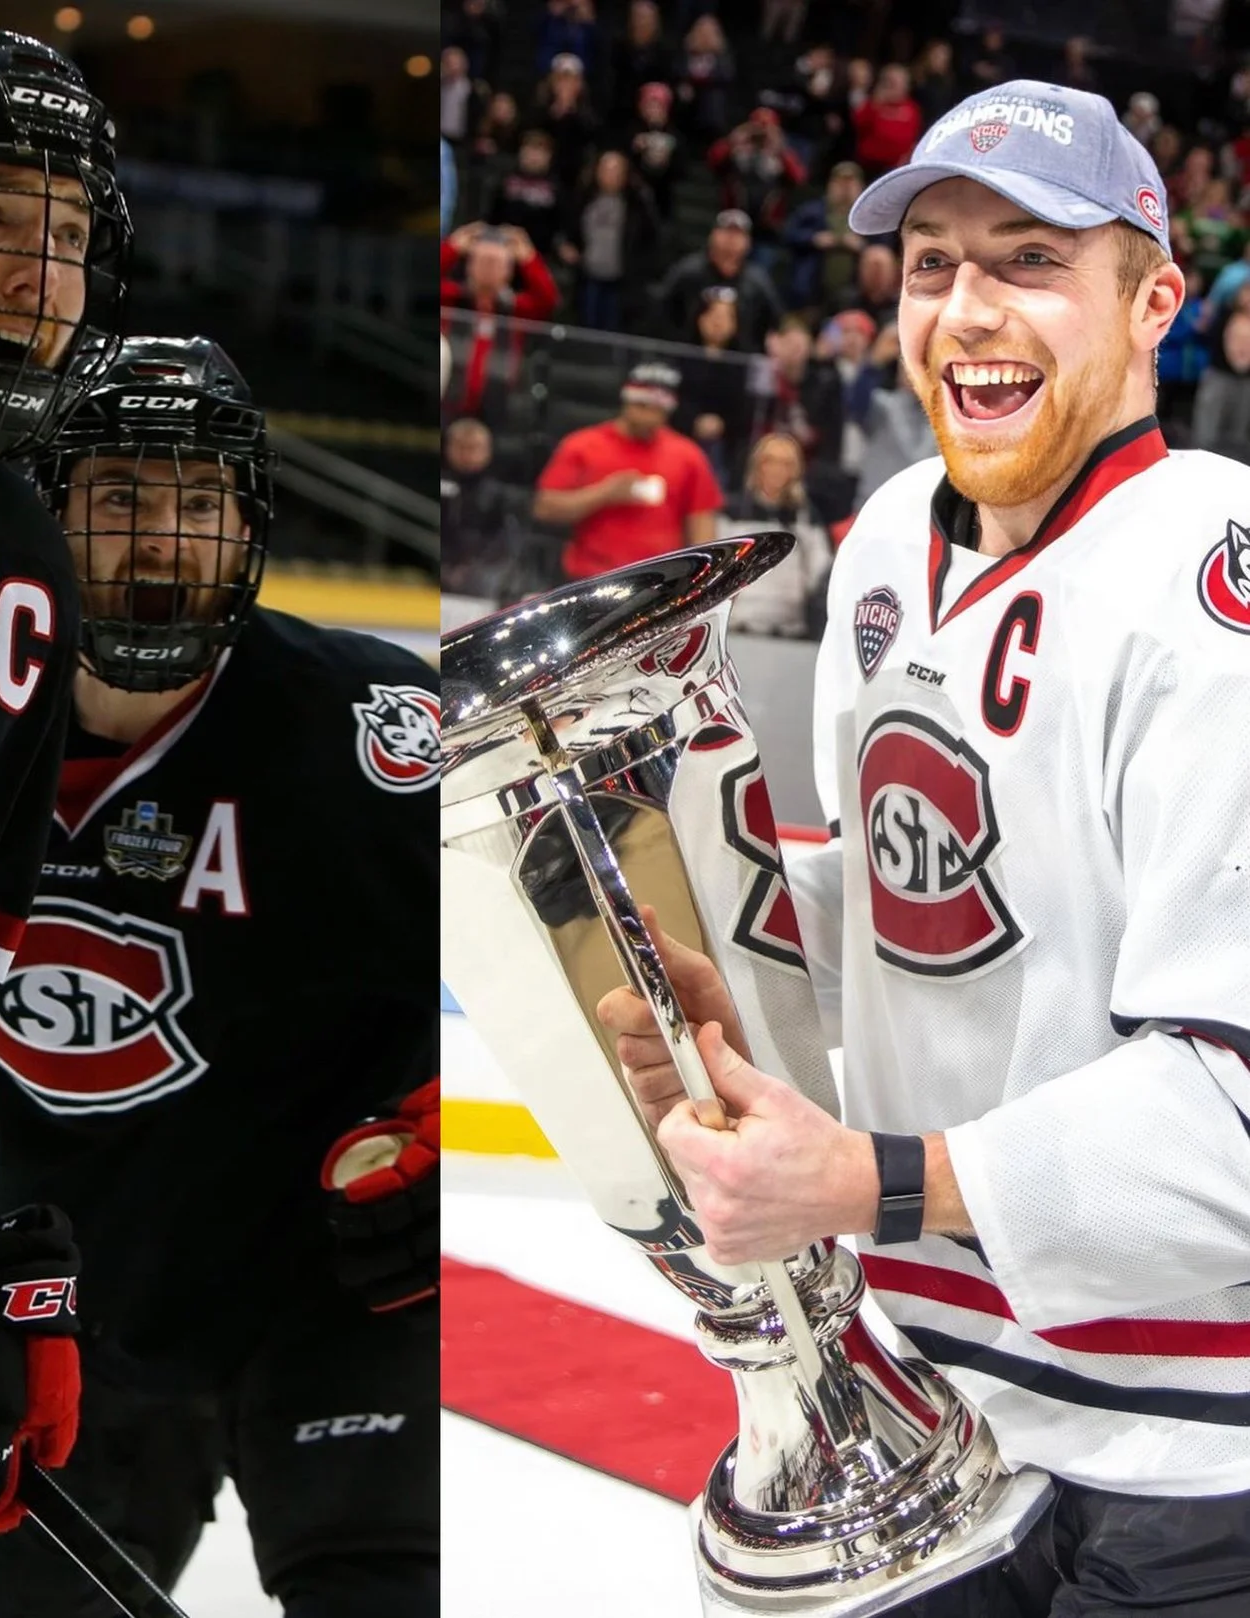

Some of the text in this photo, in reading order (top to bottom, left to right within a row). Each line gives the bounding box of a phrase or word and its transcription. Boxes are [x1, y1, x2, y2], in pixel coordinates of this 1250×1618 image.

[12, 86, 89, 118] CCM
[925, 103, 1074, 153] CHAMPIONS
[971, 124, 1009, 138] NCHC
[119, 395, 199, 411] CCM
[855, 604, 898, 635] NCHC
[114, 644, 184, 660] CCM
[981, 590, 1043, 738] C
[906, 661, 947, 686] CCM
[111, 832, 183, 853] FROZEN FOUR
[41, 863, 100, 878] CCM
[178, 797, 251, 917] A
[294, 1412, 406, 1443] CCM
